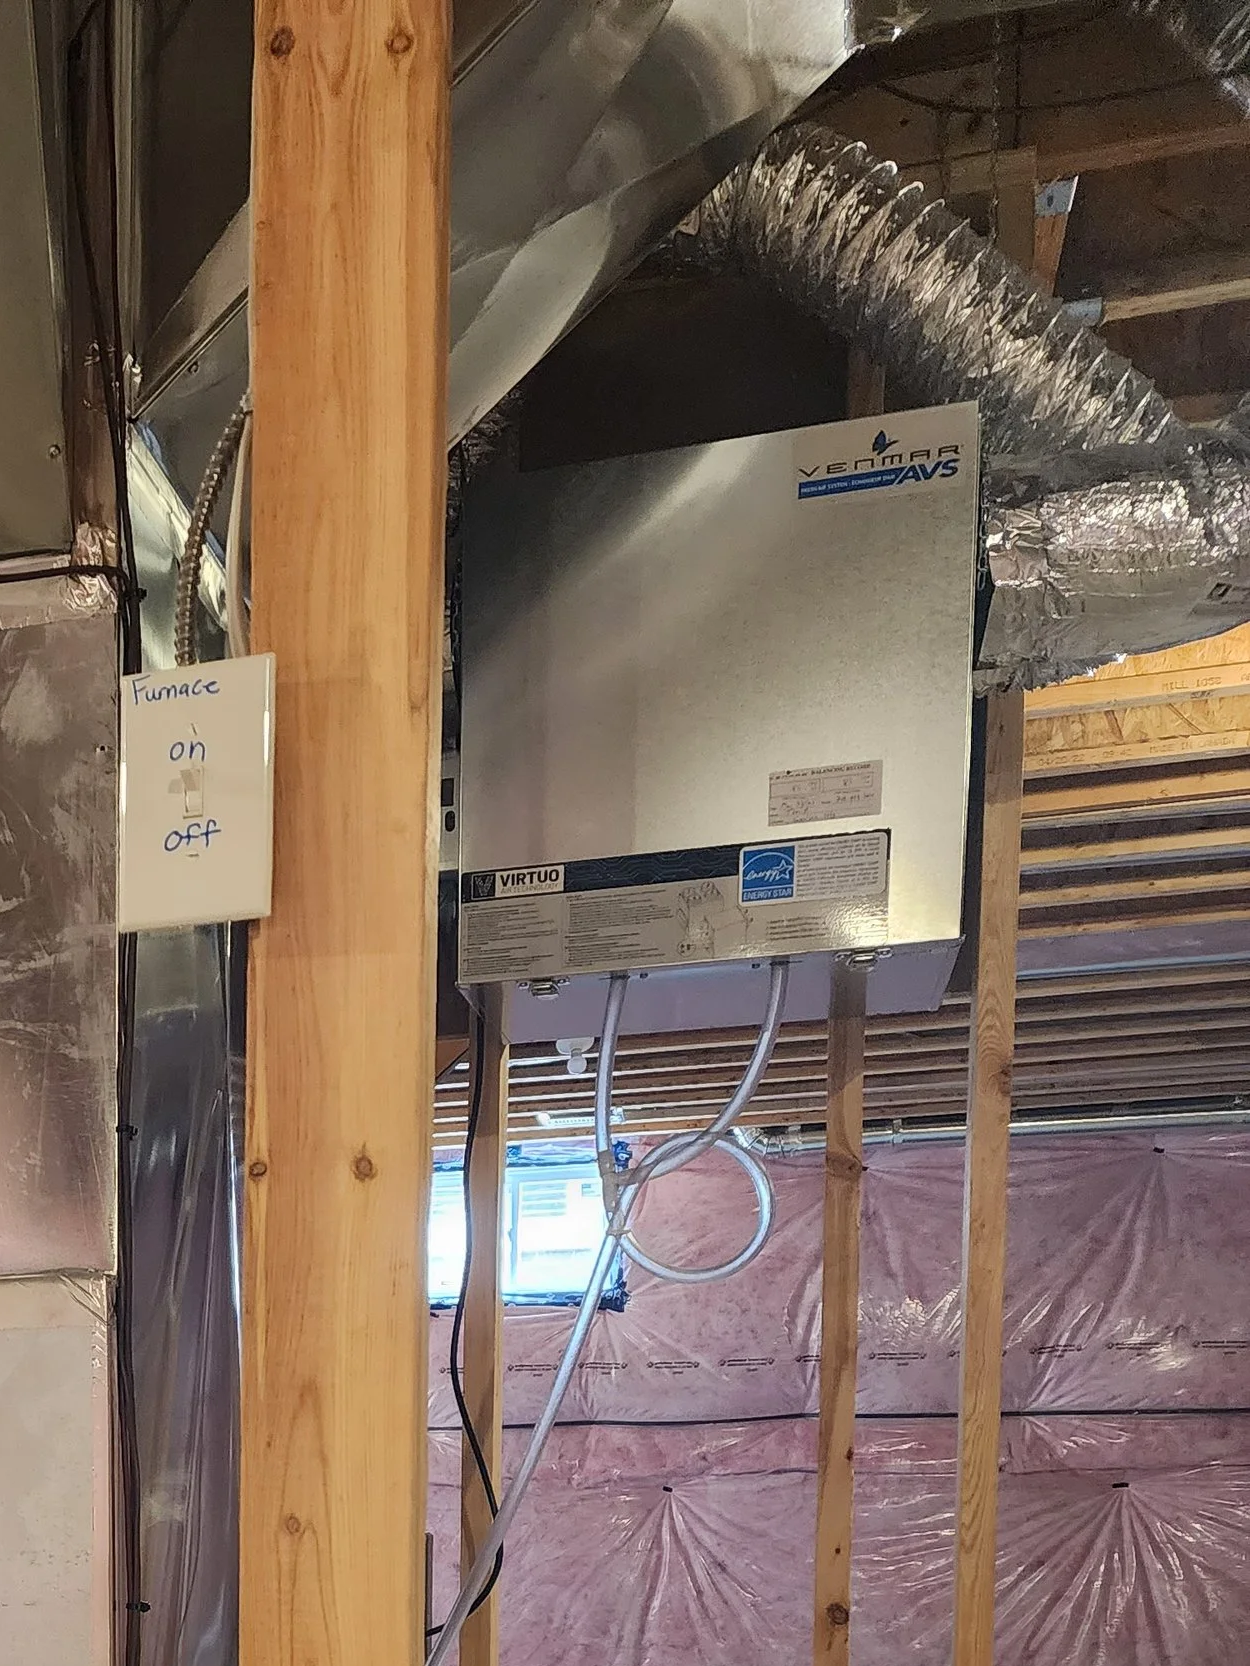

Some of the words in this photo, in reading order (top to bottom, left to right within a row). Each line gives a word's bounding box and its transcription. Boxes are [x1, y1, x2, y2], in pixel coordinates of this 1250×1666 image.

[799, 445, 954, 478] VENMAR
[896, 458, 961, 486] AVS
[131, 675, 220, 705] Furnace
[169, 740, 206, 762] on
[164, 818, 222, 852] off
[500, 868, 560, 887] VIRTUO
[743, 889, 773, 900] ENERGY
[773, 887, 792, 898] STAR
